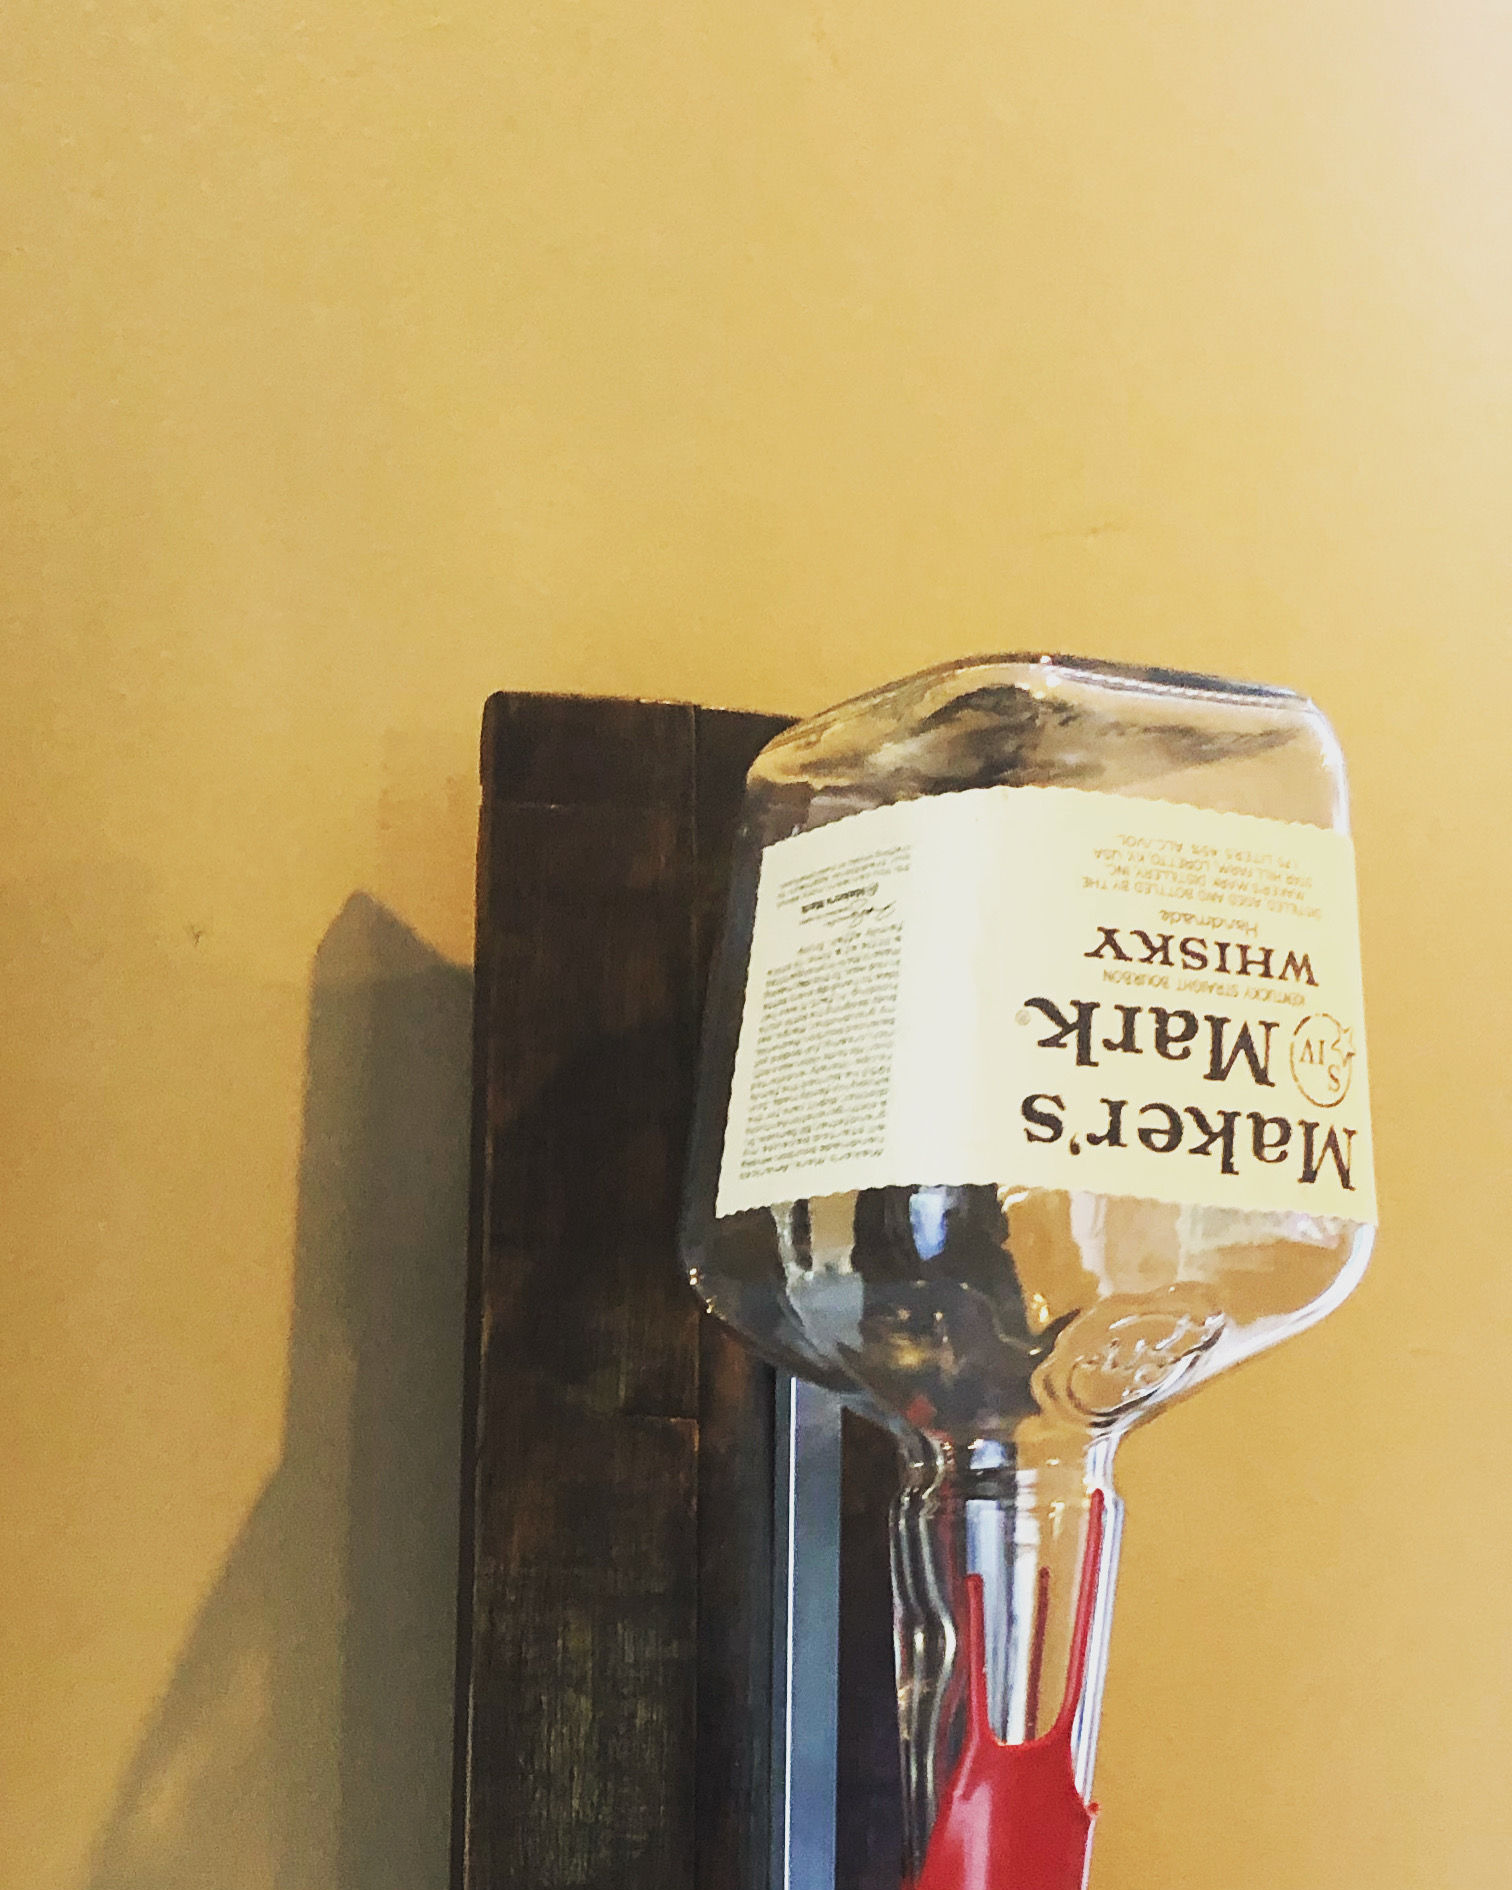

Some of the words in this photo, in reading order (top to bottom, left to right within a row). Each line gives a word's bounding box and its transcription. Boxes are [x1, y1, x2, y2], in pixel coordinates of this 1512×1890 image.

[1081, 876, 1109, 890] THE
[1113, 878, 1130, 892] BY
[1134, 882, 1194, 901] BOTTLED
[1198, 889, 1224, 904] AND
[1158, 909, 1258, 938] Handmade
[1084, 926, 1319, 987] WHISKY
[1103, 969, 1171, 991] BOURBON
[1176, 979, 1239, 999] STRAIGHT
[1244, 987, 1305, 1008] KENTUCKY
[1023, 997, 1280, 1088] Mark
[1020, 1093, 1358, 1192] Maker's
